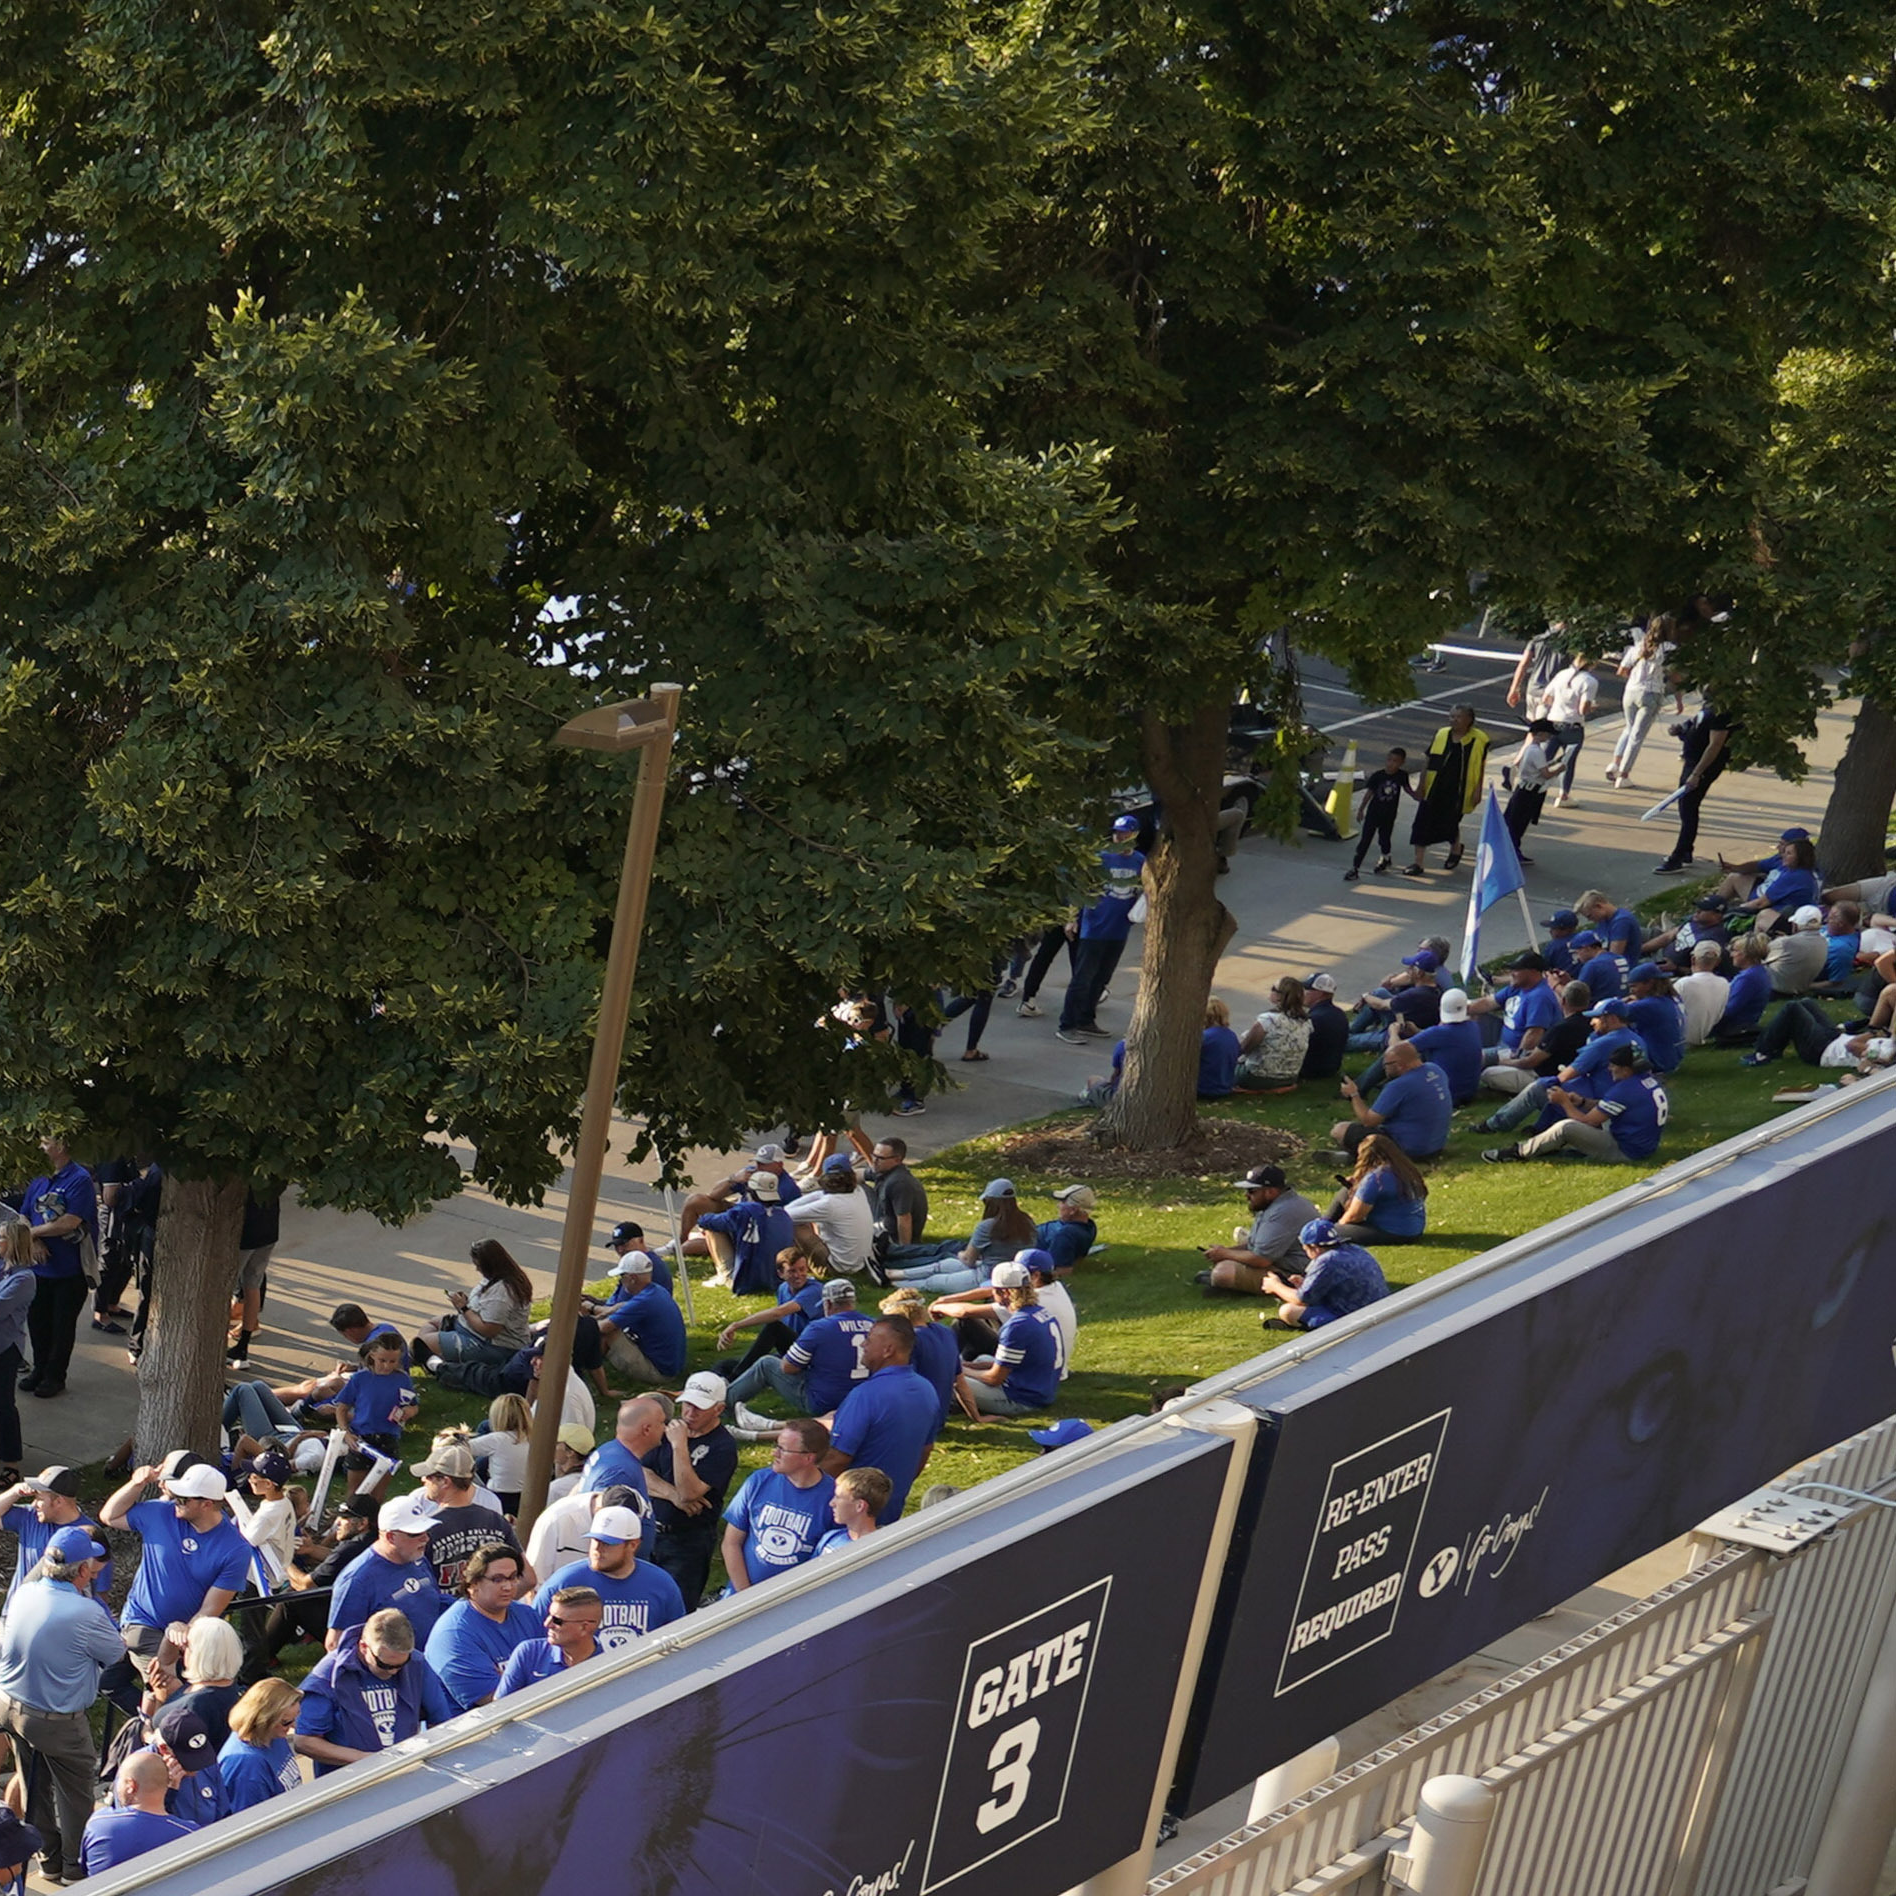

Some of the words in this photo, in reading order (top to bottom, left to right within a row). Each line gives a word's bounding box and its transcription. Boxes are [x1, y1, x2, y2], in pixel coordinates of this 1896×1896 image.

[839, 1320, 872, 1334] WILSO
[850, 1334, 869, 1379] 1
[1323, 1453, 1432, 1533] RE-ENTER
[757, 1506, 812, 1540] FOOTBALL
[1334, 1527, 1391, 1581] PASS
[597, 1604, 648, 1634] OTBALL
[1292, 1571, 1404, 1655] REQUIRED
[969, 1620, 1092, 1728] GATE
[977, 1715, 1037, 1832] 3
